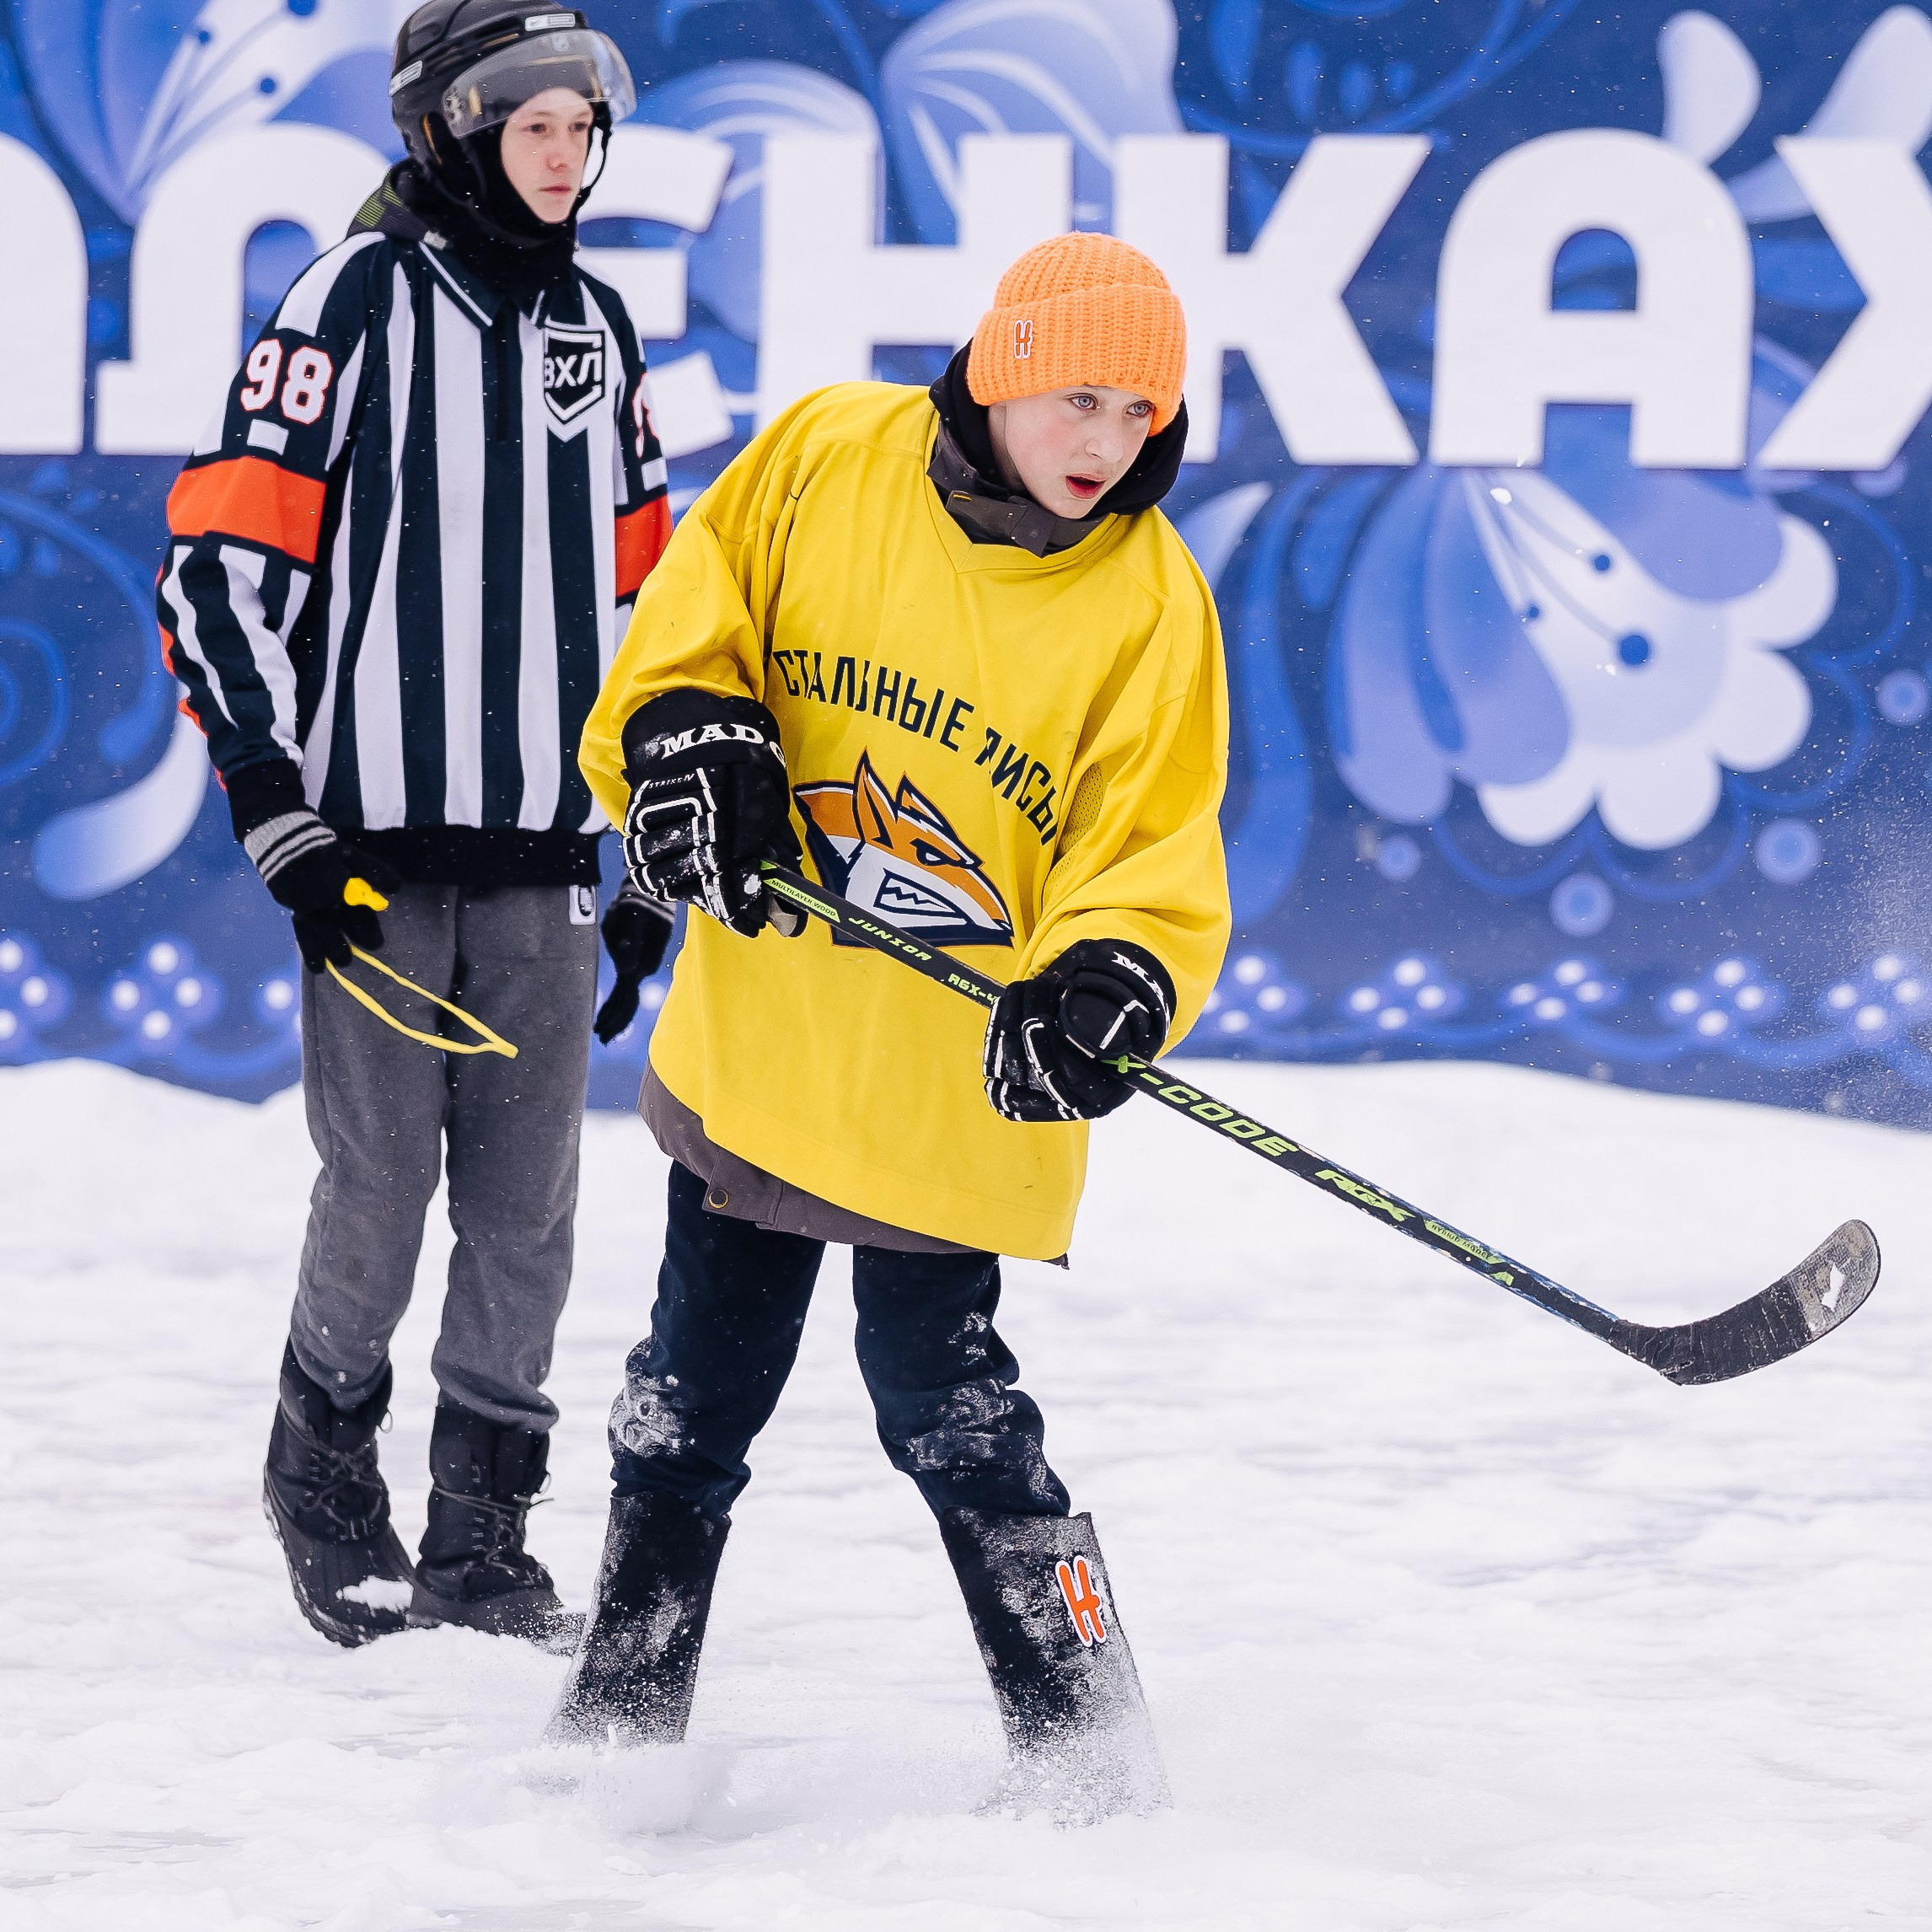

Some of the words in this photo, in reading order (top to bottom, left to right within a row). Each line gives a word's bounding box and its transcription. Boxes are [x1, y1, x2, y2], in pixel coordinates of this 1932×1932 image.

[0, 124, 1932, 470] ЛЕНКАХ
[240, 338, 334, 425] 98
[544, 351, 602, 389] ВХЛ
[773, 649, 975, 753] СТАЛЬНЫЕ
[660, 723, 764, 759] MAD
[771, 878, 813, 905] MULTILAYER
[813, 901, 836, 917] WOOD
[848, 916, 932, 961] JUNIOR
[1101, 1055, 1299, 1157] X-CODE
